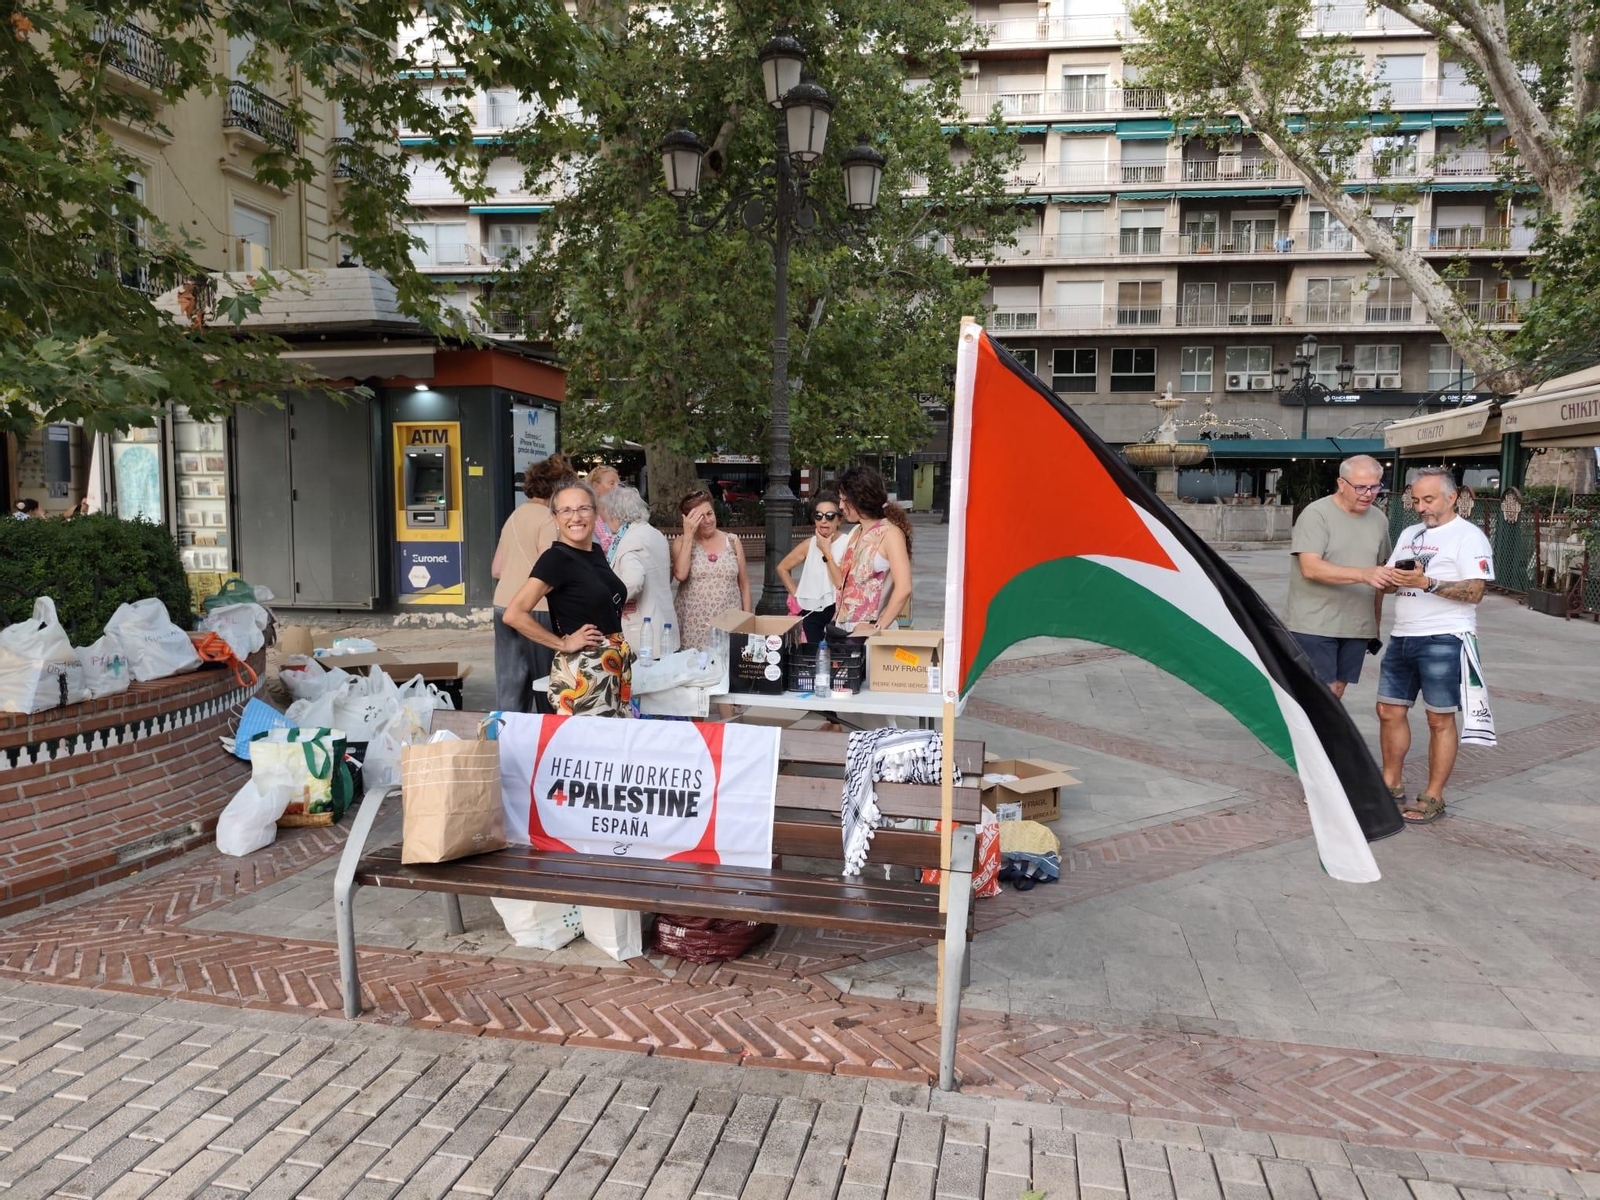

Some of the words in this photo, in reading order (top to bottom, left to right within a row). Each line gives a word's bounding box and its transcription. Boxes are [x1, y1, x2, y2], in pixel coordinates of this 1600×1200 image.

[1560, 399, 1600, 421] CHIKIT
[411, 429, 449, 444] ATM
[1213, 431, 1251, 439] CaixaBank
[1417, 424, 1444, 441] CHIKITO
[412, 554, 448, 563] Euronet
[882, 664, 900, 672] MUY
[550, 757, 614, 782] HEALTH
[620, 763, 703, 790] WORKERS
[546, 779, 701, 818] 4PALESTINE
[591, 816, 649, 838] ESPAÑA
